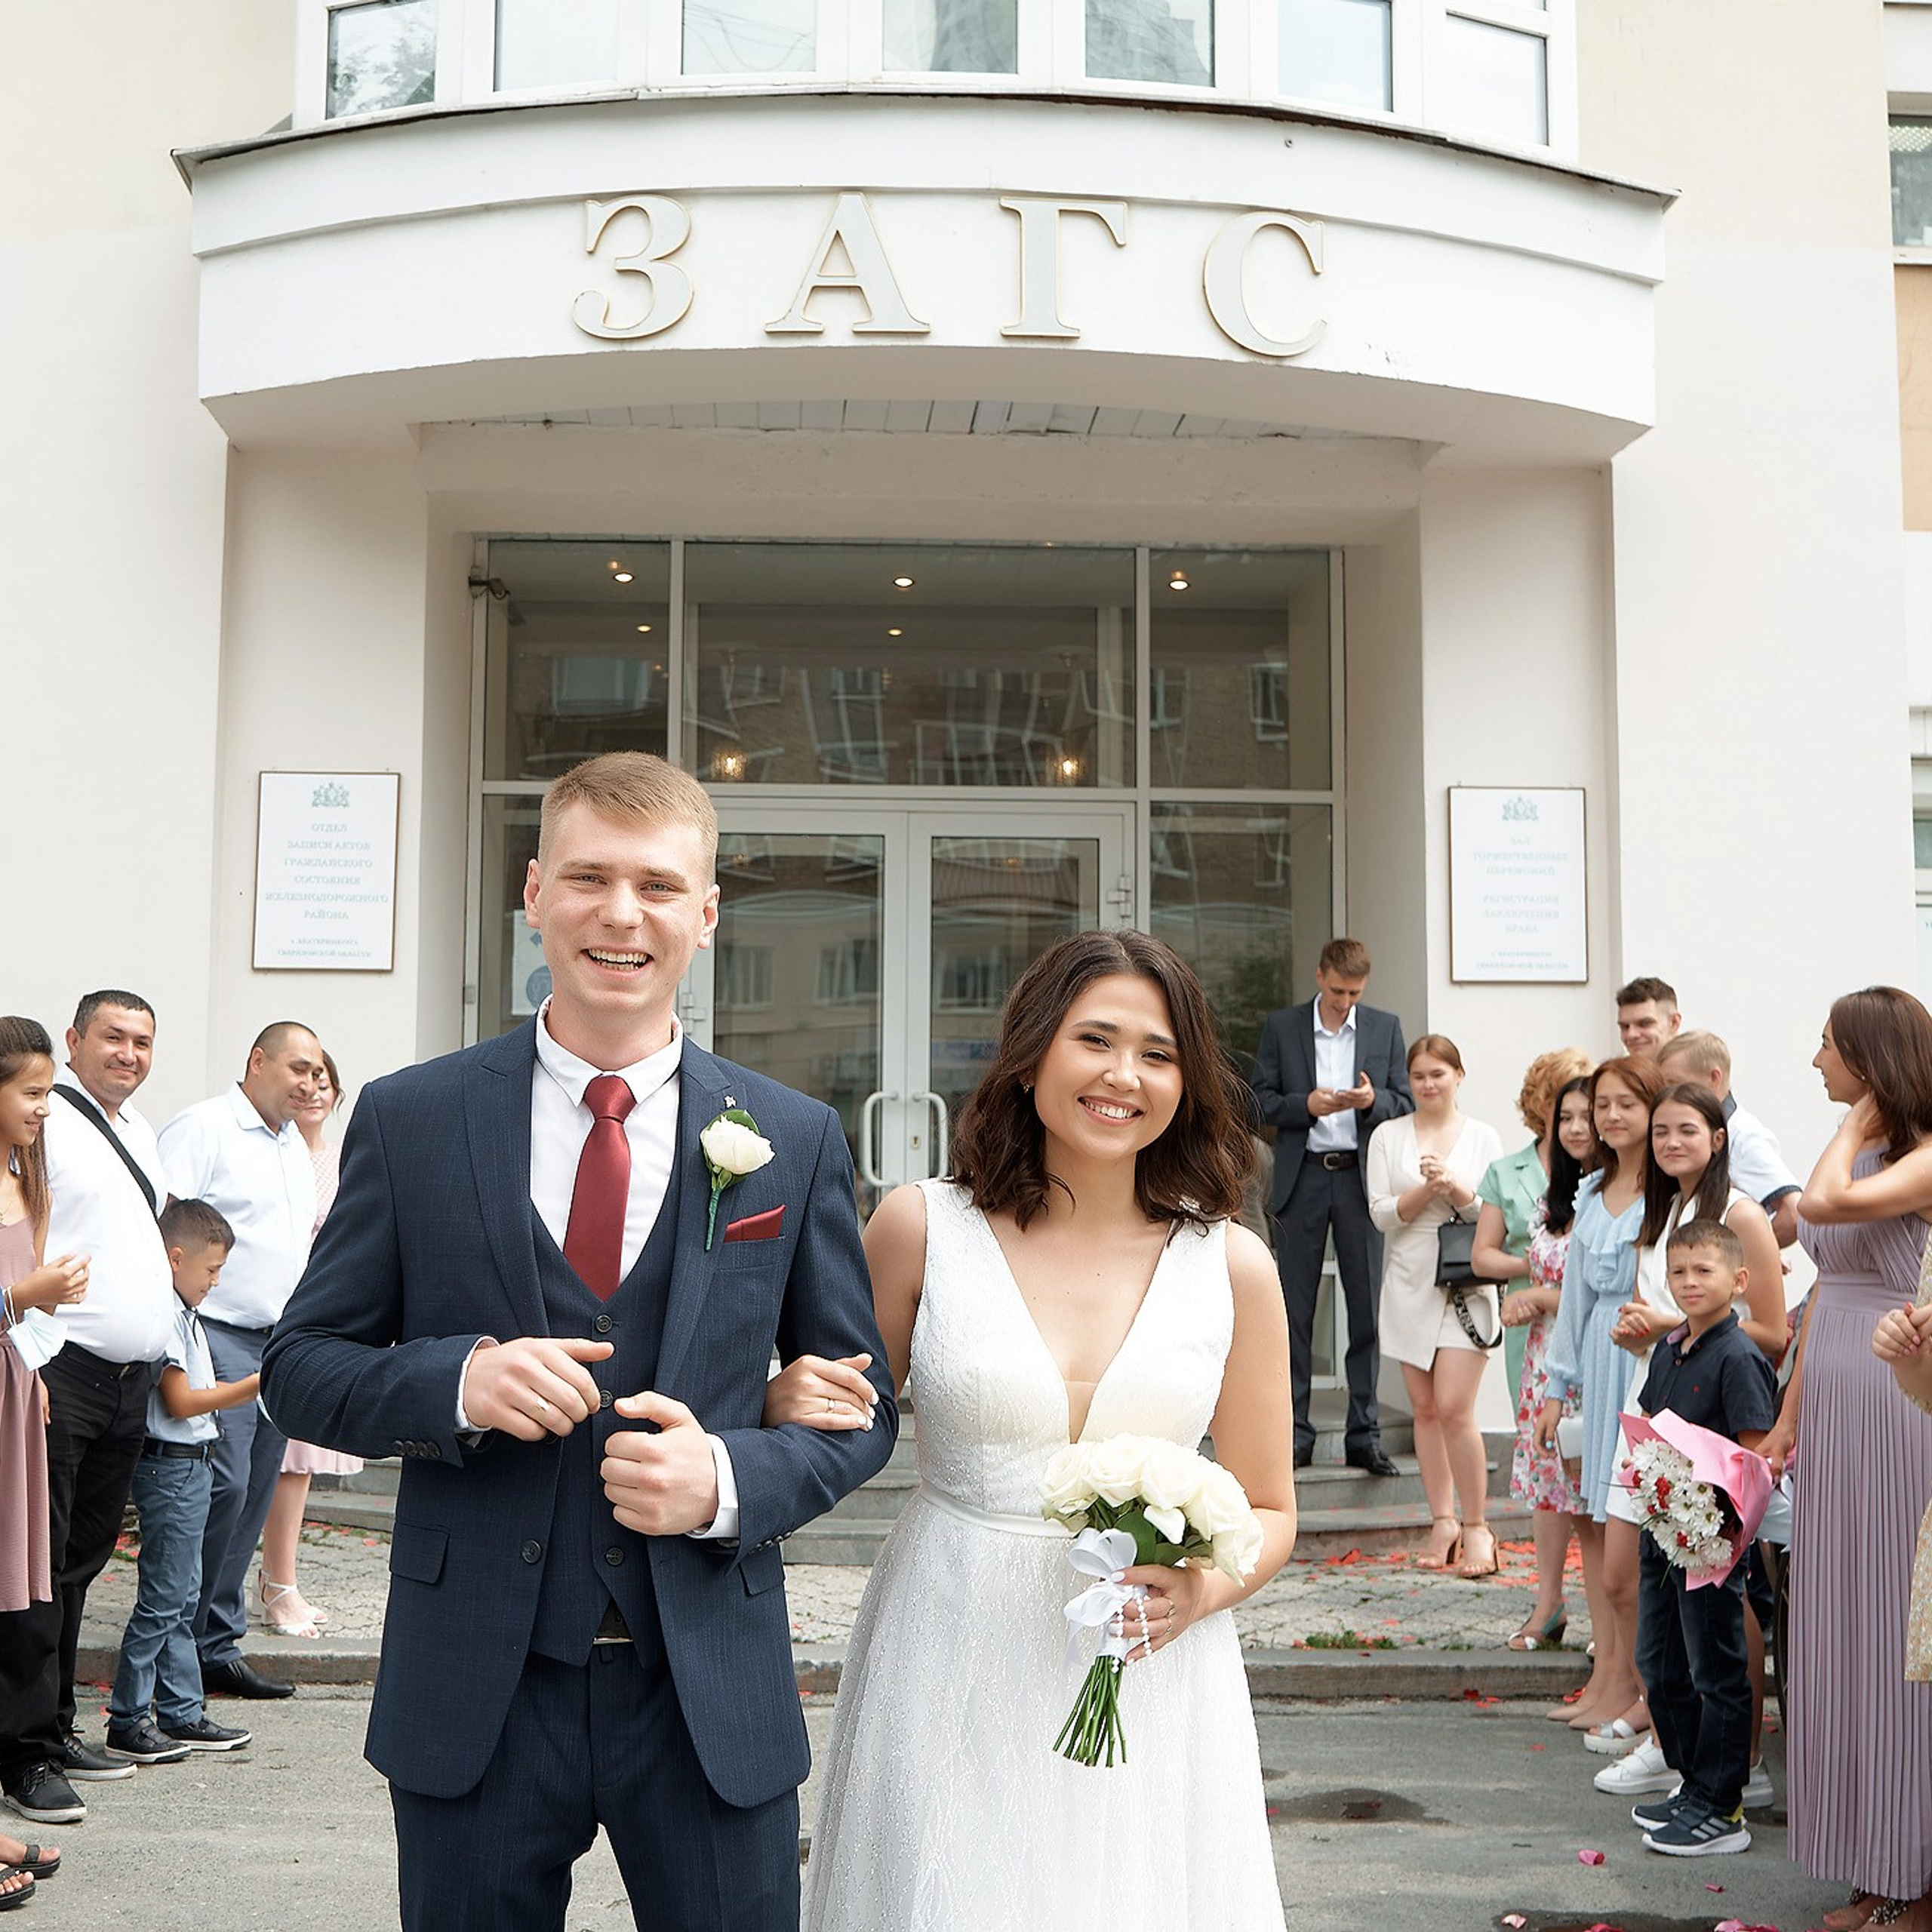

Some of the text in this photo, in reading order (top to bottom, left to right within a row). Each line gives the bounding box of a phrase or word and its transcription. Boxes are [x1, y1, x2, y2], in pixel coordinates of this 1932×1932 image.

[571, 190, 1328, 358] ЗАГС
[311, 823, 348, 833] ОТДЕЛ
[287, 840, 371, 851] ЗАПИСИ АКТОВ
[284, 857, 373, 868] ГРАЖДАНСКОГО
[294, 875, 361, 885] СОСТОЯНИЯ
[265, 892, 389, 903] ЖЕЛЕЗНОДОРОЖНОГО
[304, 908, 349, 920] РАЙОНА
[1505, 924, 1540, 934] БРАКА
